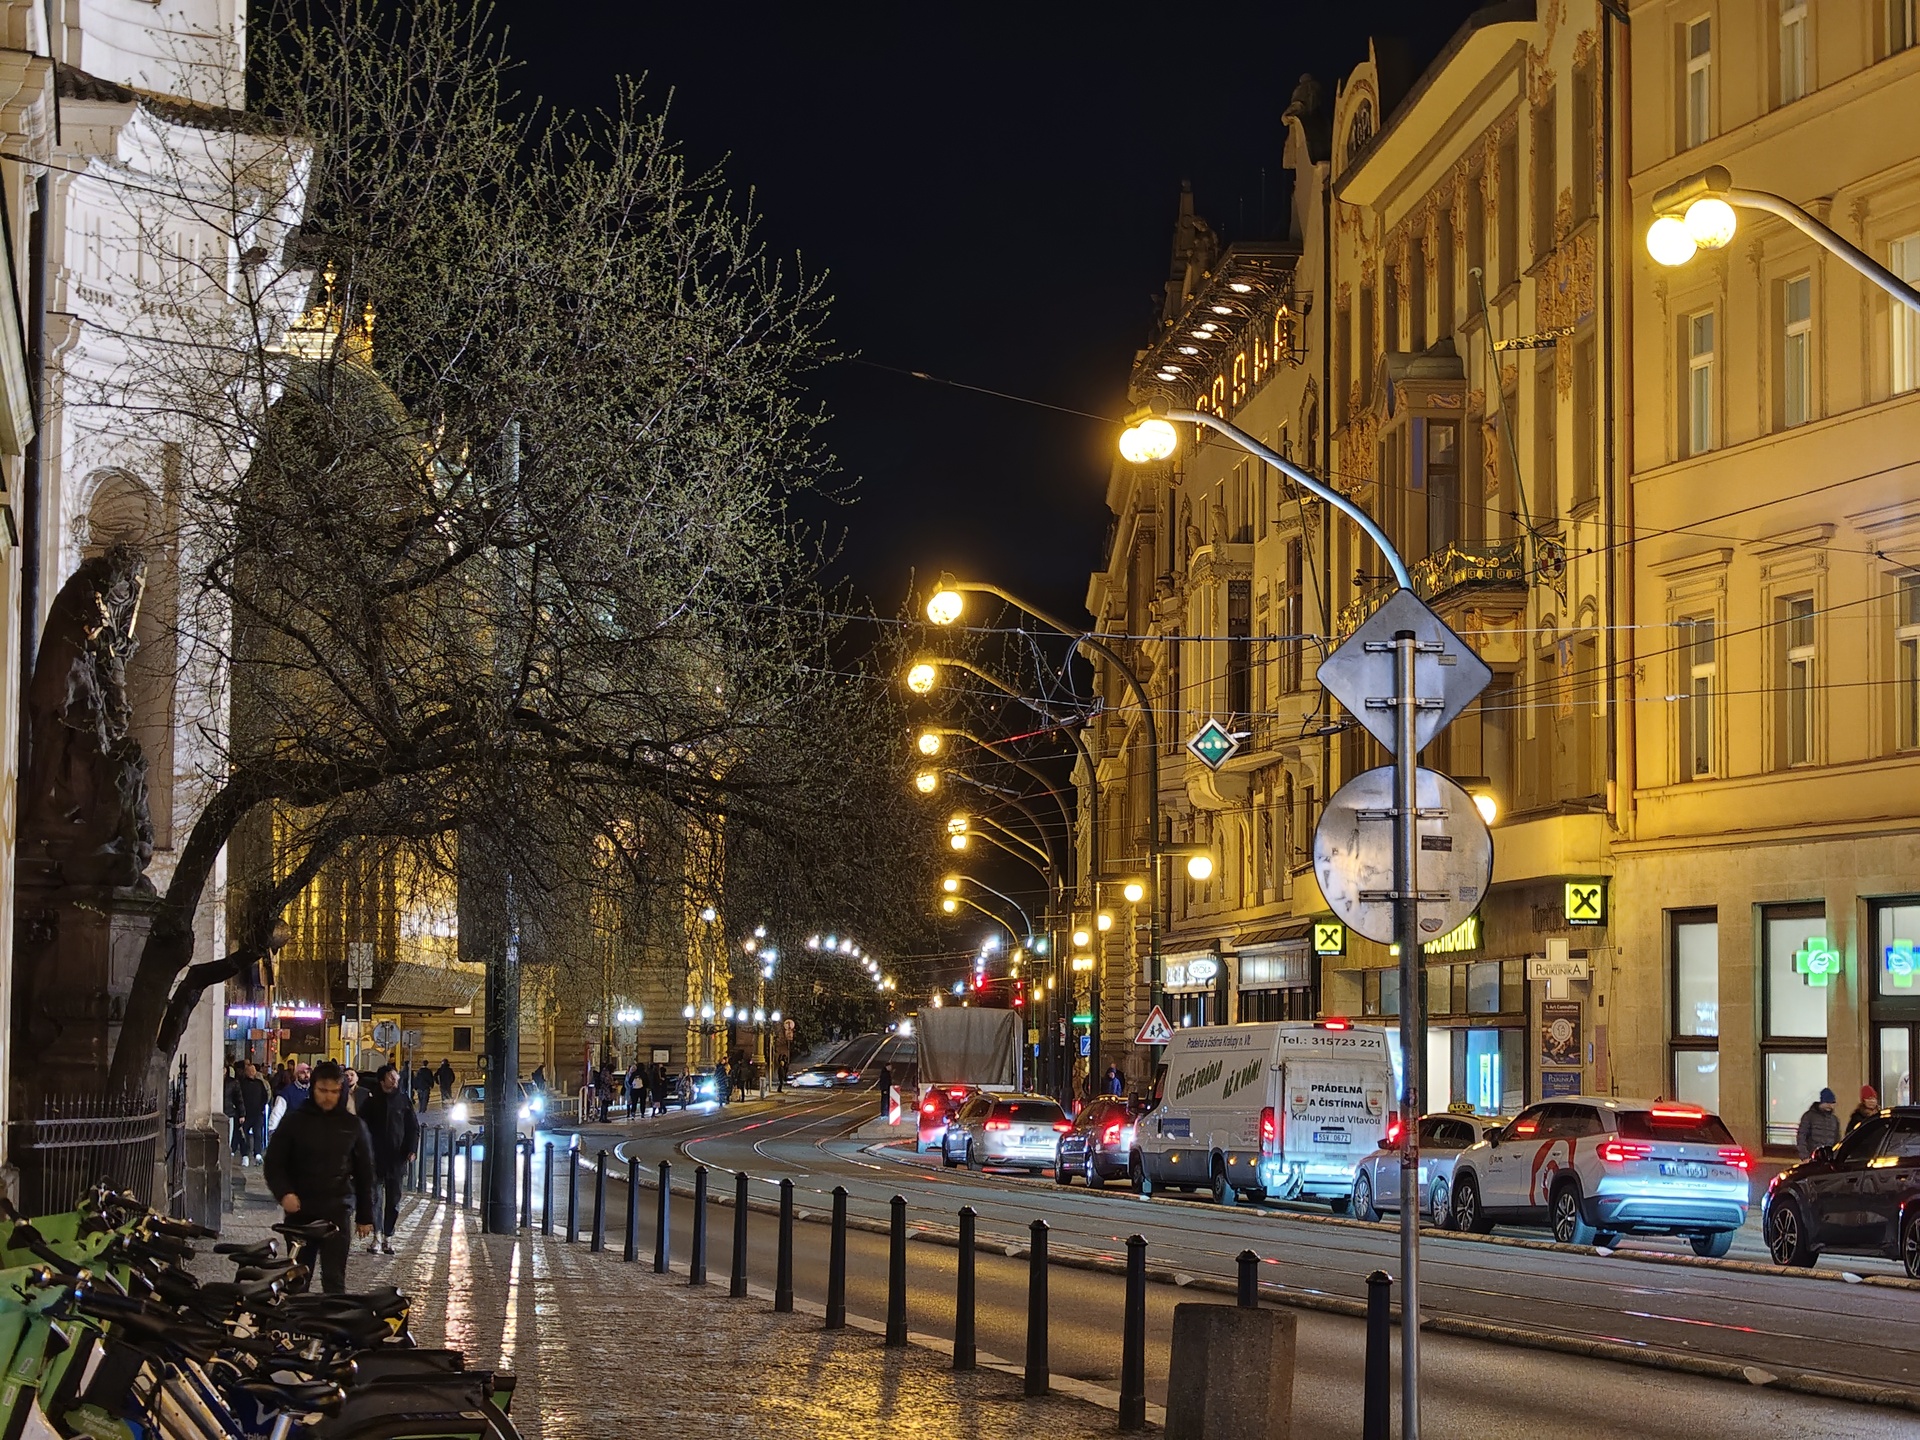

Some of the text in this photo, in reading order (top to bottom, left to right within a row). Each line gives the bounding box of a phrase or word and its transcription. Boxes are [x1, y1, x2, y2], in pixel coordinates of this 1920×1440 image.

[1535, 963, 1582, 976] POLIKLINIKA
[1281, 1036, 1381, 1048] Tel.: 315723 221
[1311, 1083, 1363, 1094] PRÁDELNA
[1309, 1097, 1364, 1109] A ČISTÍRNA
[1292, 1113, 1381, 1125] Kralupy nad Vltavou
